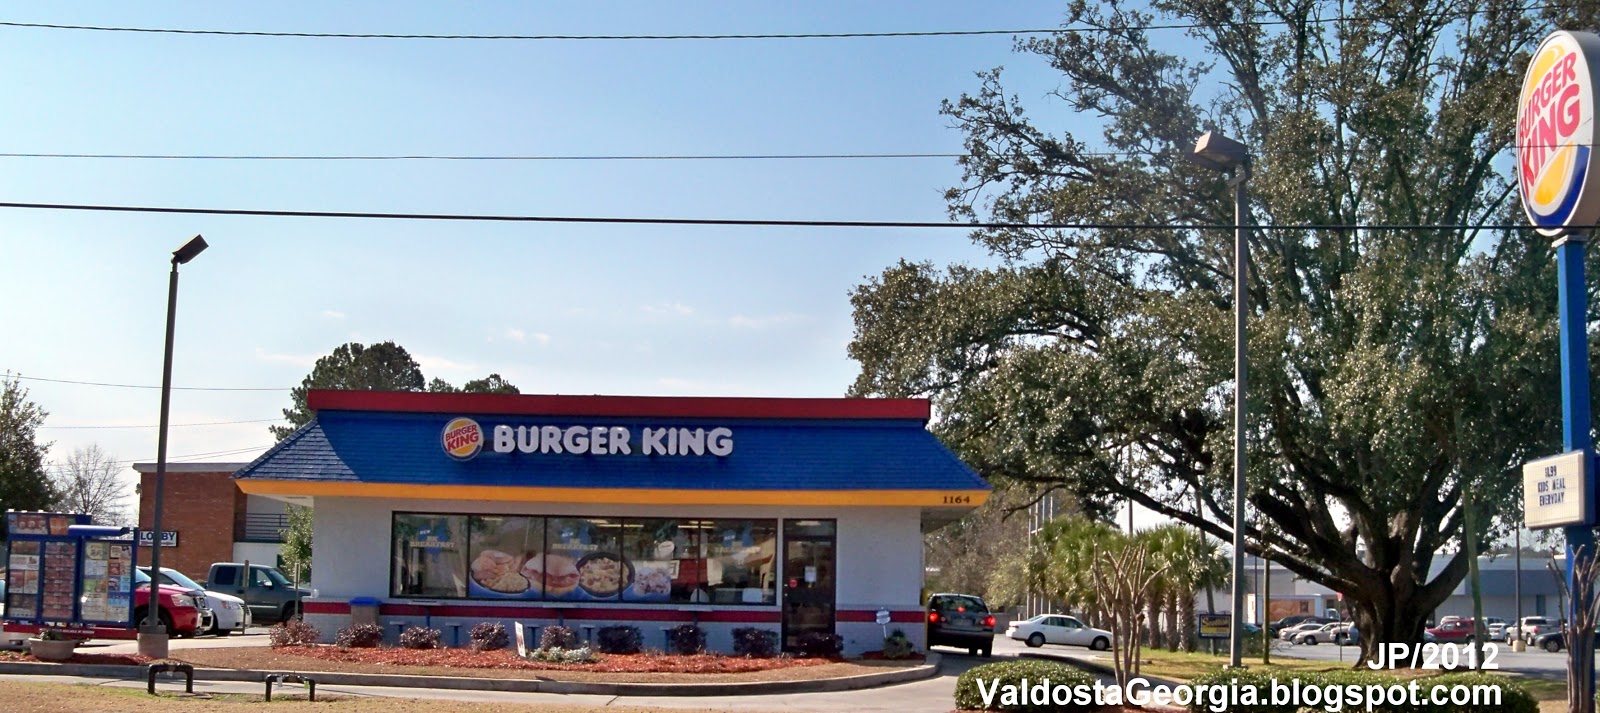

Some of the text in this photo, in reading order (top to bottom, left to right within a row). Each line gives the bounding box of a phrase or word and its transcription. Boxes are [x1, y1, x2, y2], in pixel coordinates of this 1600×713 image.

[1520, 52, 1577, 144] BURGER
[1521, 83, 1581, 200] KING
[446, 424, 477, 441] BURGER
[493, 425, 733, 456] BURGER KING
[447, 432, 479, 452] KING
[1537, 478, 1565, 492] KIDS MEAL
[943, 496, 970, 504] 1164
[1540, 492, 1565, 506] EVERYDAY
[140, 532, 175, 541] LOBY
